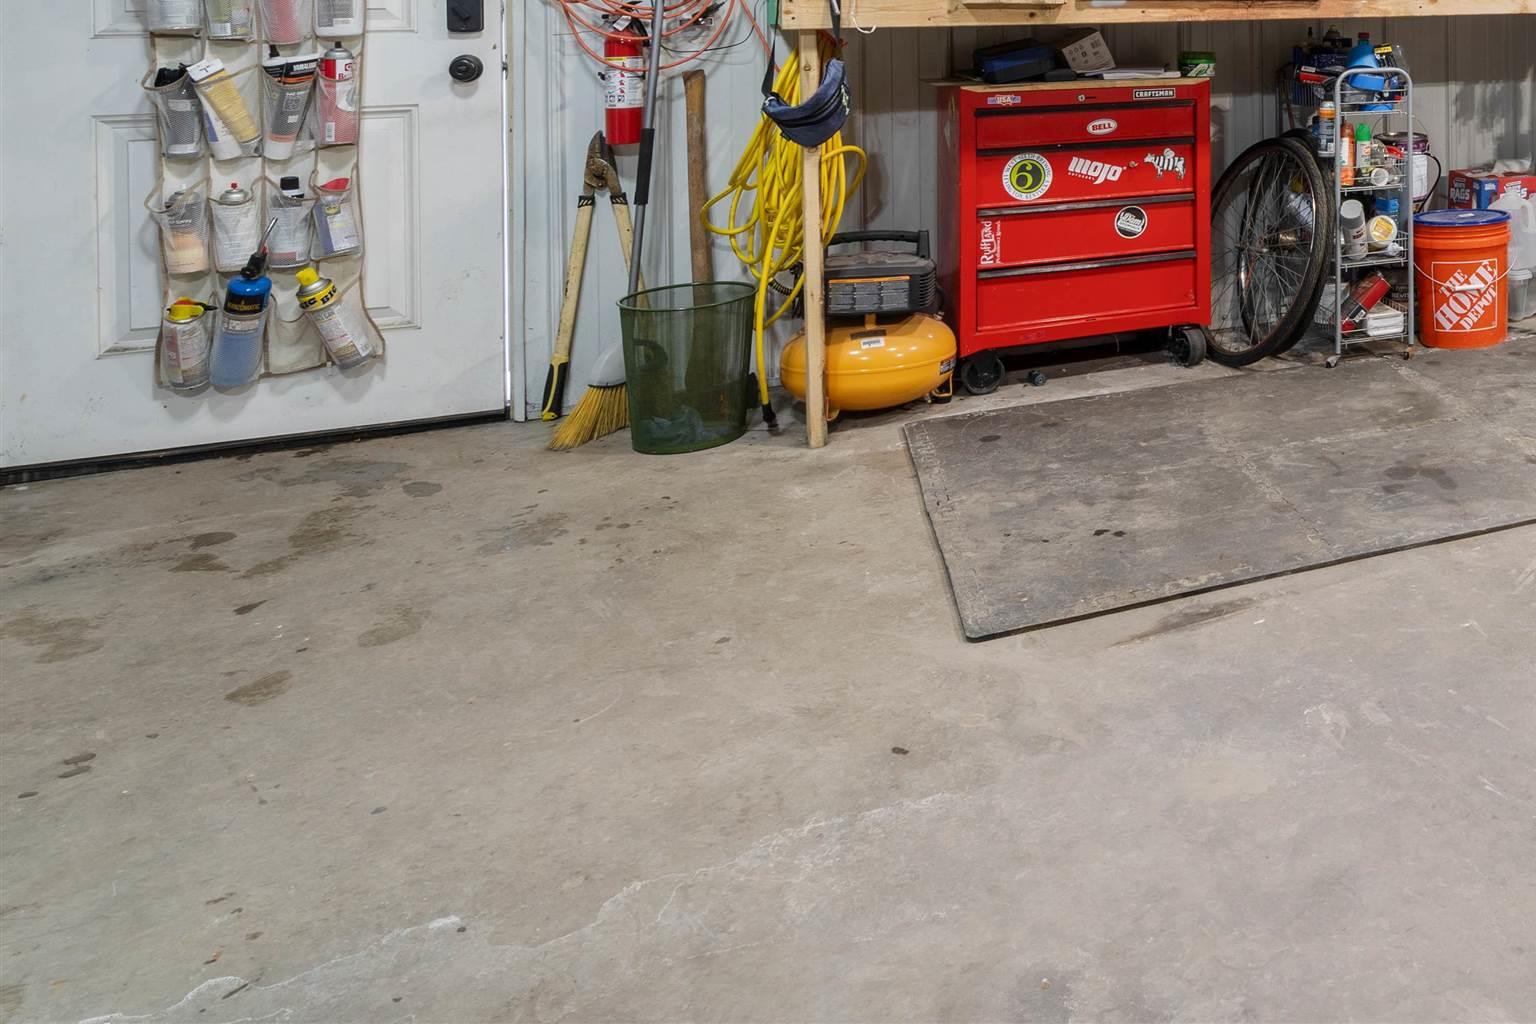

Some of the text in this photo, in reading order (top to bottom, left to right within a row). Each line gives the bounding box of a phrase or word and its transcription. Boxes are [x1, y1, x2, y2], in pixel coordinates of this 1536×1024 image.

[1135, 90, 1174, 98] CRAFTSMAN
[1091, 123, 1113, 132] BELL
[1011, 160, 1033, 190] 6
[1450, 187, 1470, 203] RAGS
[1439, 269, 1468, 297] THE
[1459, 285, 1497, 330] DEPOT
